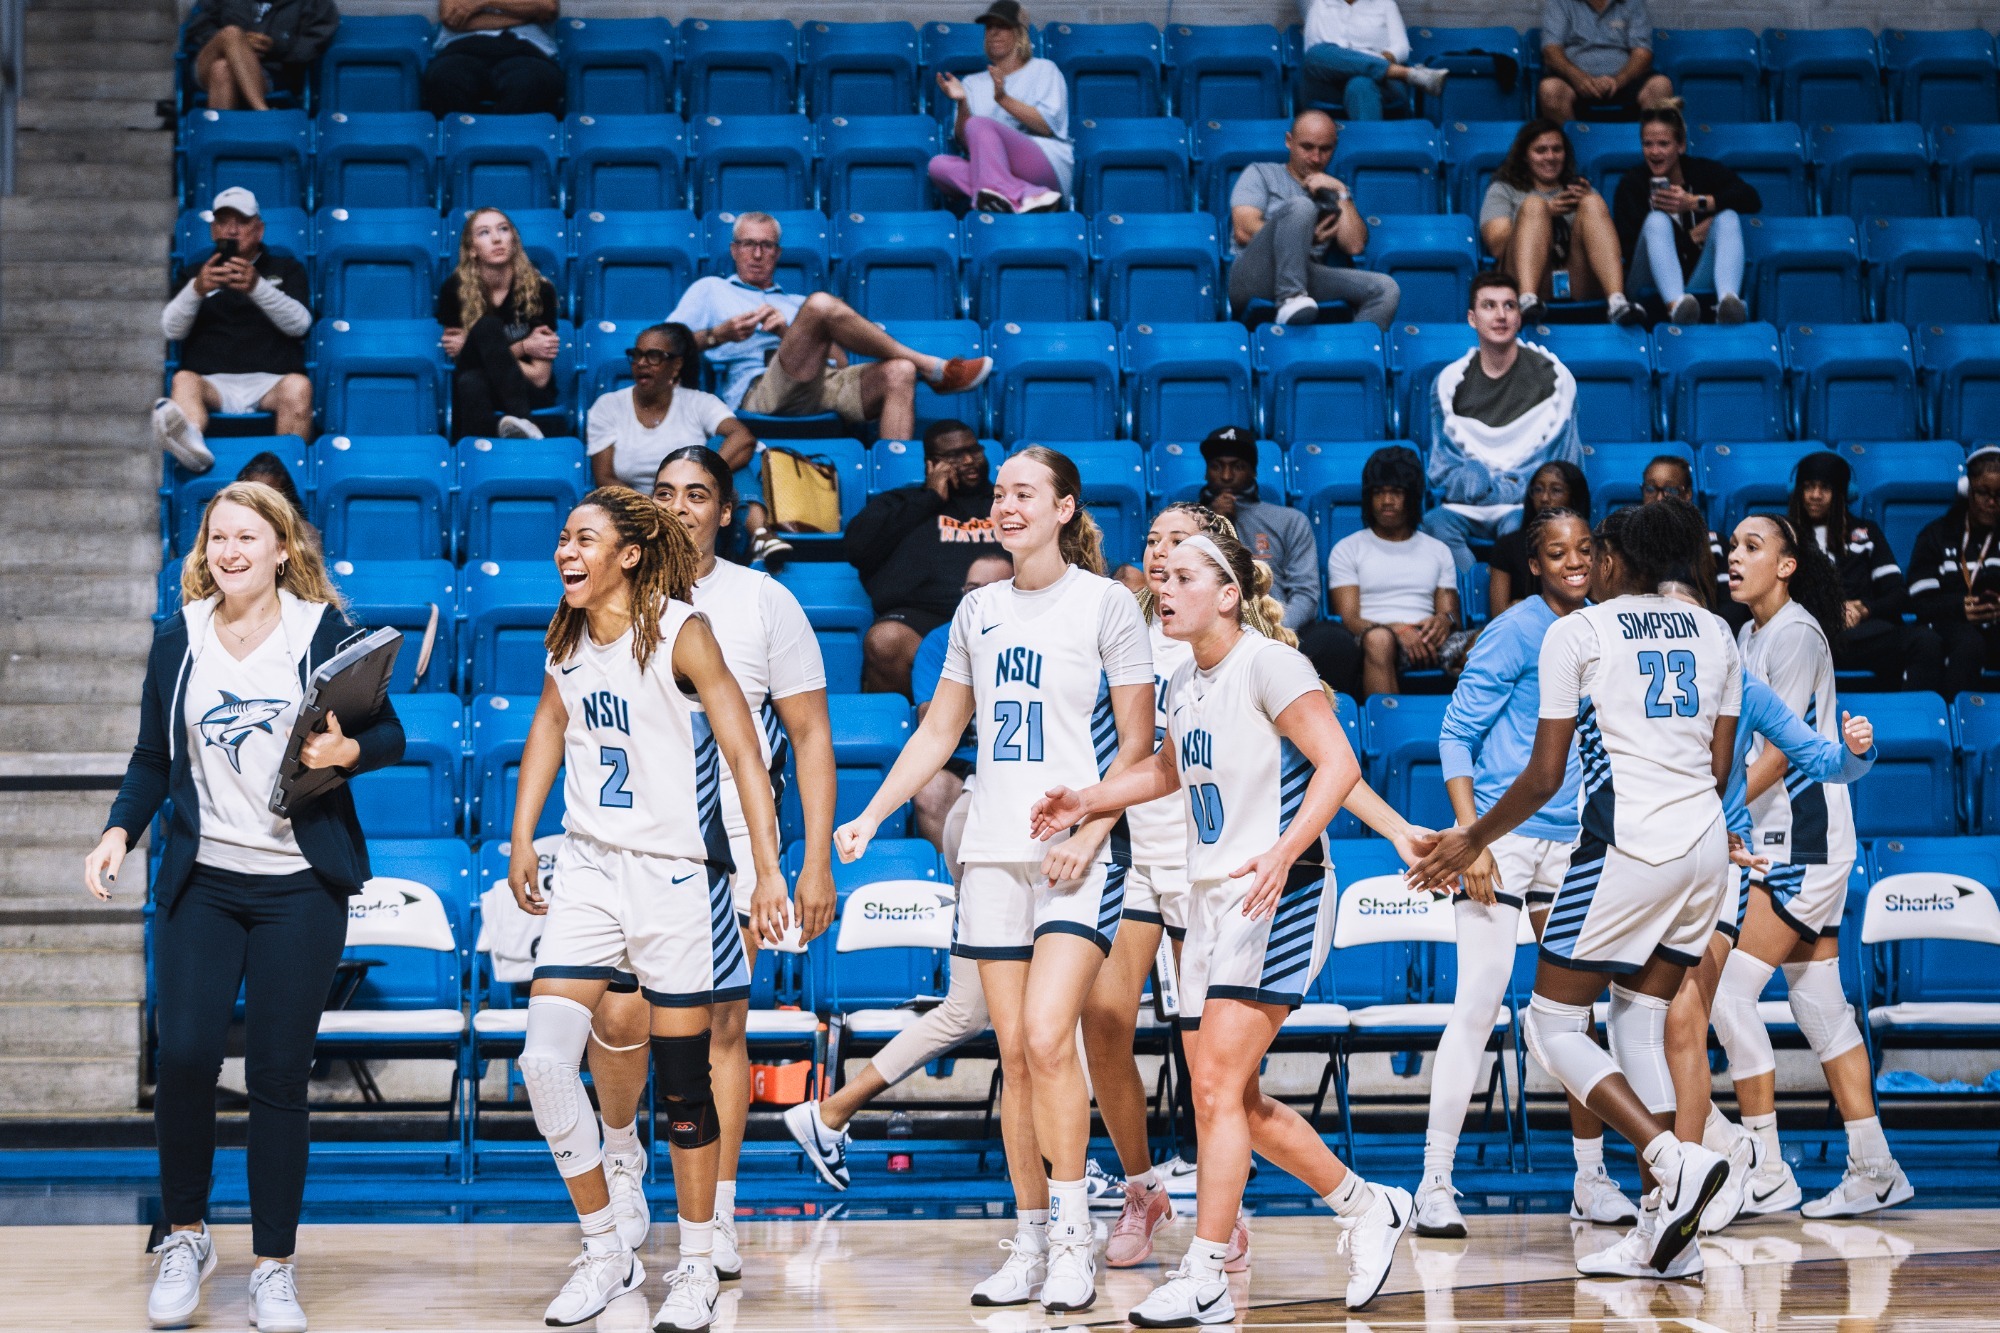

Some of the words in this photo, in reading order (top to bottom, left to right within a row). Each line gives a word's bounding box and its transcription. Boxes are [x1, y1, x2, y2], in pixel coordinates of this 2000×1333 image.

[1617, 612, 1700, 640] SIMPSON
[996, 646, 1043, 690] NSU
[1637, 649, 1700, 718] 23
[582, 691, 631, 737] NSU
[993, 700, 1044, 762] 21
[1181, 728, 1213, 773] NSU
[599, 745, 633, 809] 2
[1189, 783, 1225, 845] 10
[863, 902, 935, 920] Sharks
[1358, 897, 1429, 915] Sharks
[1885, 893, 1955, 912] Sharks
